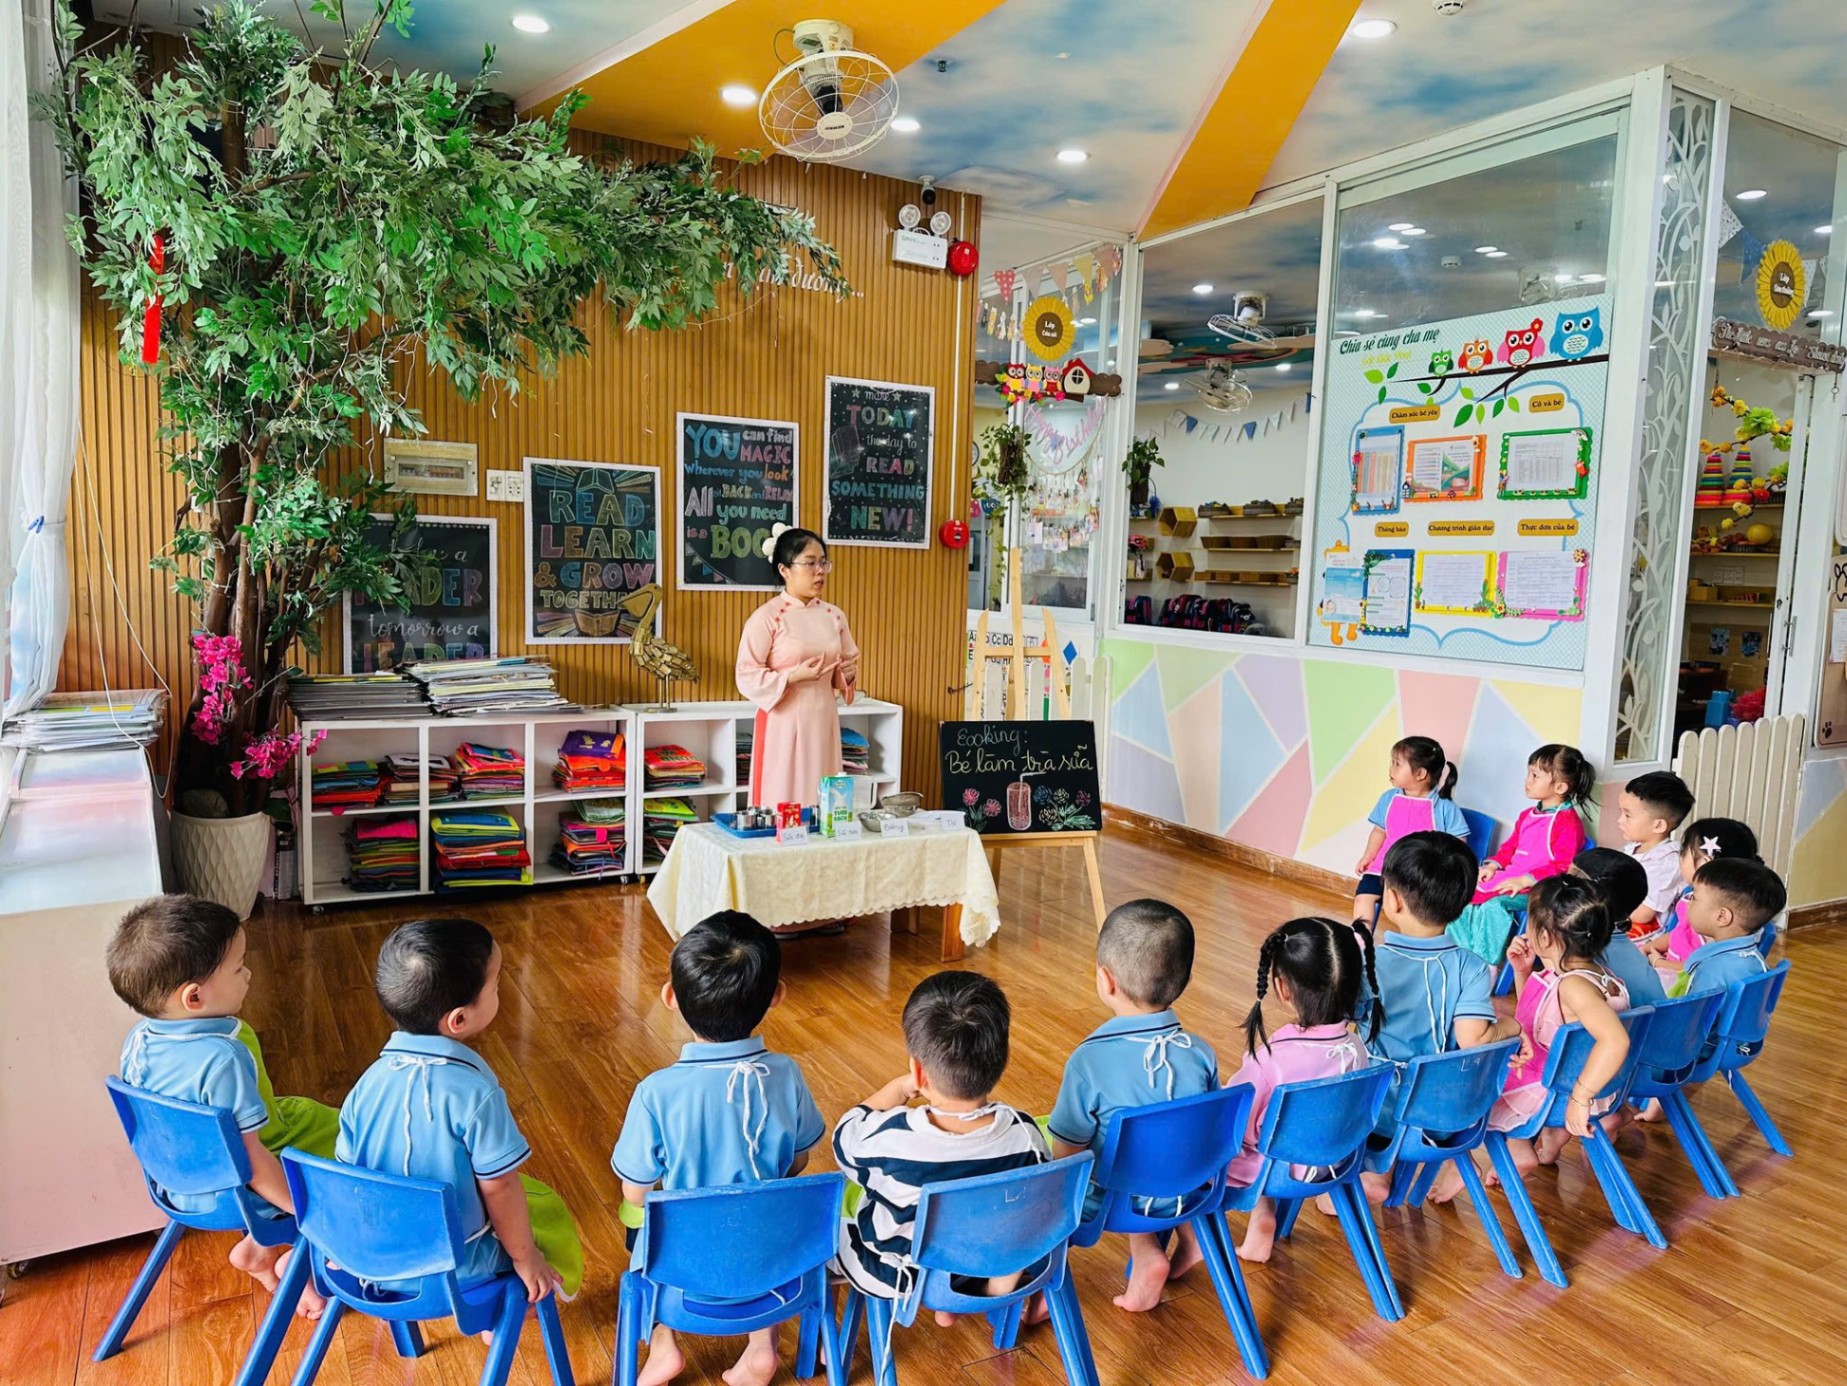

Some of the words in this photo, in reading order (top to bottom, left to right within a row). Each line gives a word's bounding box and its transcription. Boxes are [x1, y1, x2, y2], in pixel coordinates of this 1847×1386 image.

[1340, 339, 1361, 354] Chia
[1363, 335, 1375, 351] sẻ
[1377, 334, 1400, 350] cùng
[1402, 329, 1421, 345] cha
[1422, 328, 1440, 344] mẹ
[846, 404, 917, 429] TODAY
[685, 423, 741, 460] YOU
[742, 429, 765, 442] can
[766, 428, 793, 445] find
[740, 443, 792, 465] MAGIC
[886, 434, 904, 456] day
[907, 437, 918, 450] to
[684, 460, 735, 476] wherever
[738, 469, 763, 484] you
[763, 463, 789, 481] look
[866, 457, 915, 476] READ
[722, 483, 753, 499] BACK
[832, 481, 925, 499] SOMETHING
[550, 490, 645, 525] READ
[684, 485, 714, 517] All
[716, 505, 748, 526] you
[751, 503, 787, 521] need
[851, 505, 914, 532] NEW!
[540, 525, 656, 559] LEARN
[710, 524, 771, 559] BOO
[534, 561, 557, 588] &
[560, 561, 656, 589] GROW
[540, 589, 629, 609] TOGETH
[368, 613, 464, 638] tomorrow
[466, 624, 479, 636] a
[945, 750, 972, 774] Bé
